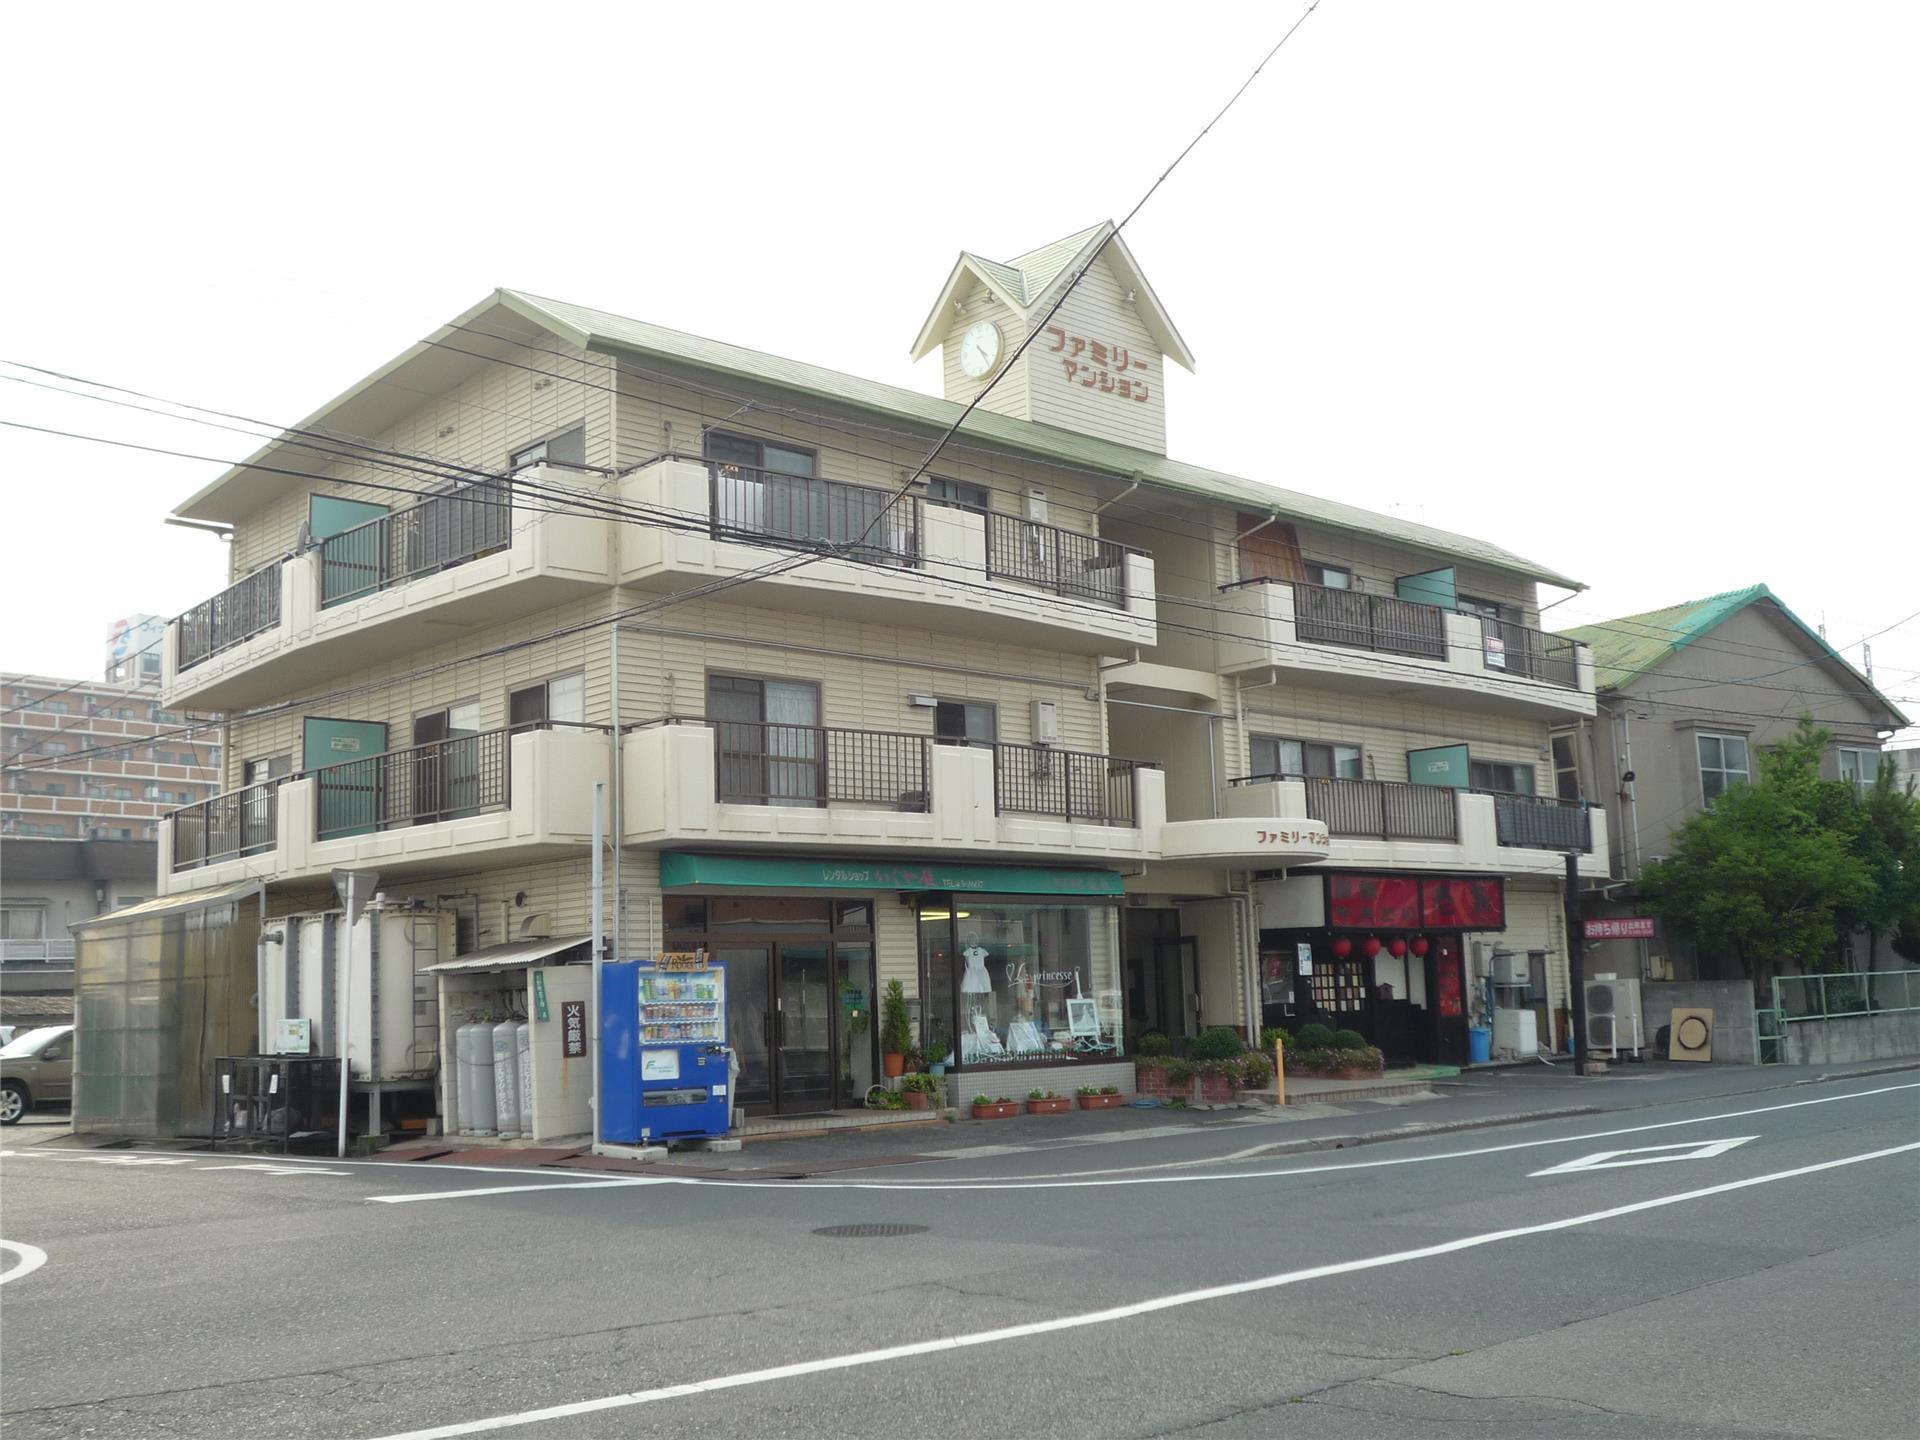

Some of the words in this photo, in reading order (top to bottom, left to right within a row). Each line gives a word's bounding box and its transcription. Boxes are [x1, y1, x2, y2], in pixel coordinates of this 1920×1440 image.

[1047, 324, 1148, 372] ファミリー
[1062, 357, 1149, 402] マンション
[822, 868, 870, 881] レンタルショップ
[567, 1004, 582, 1055] 火気厳禁
